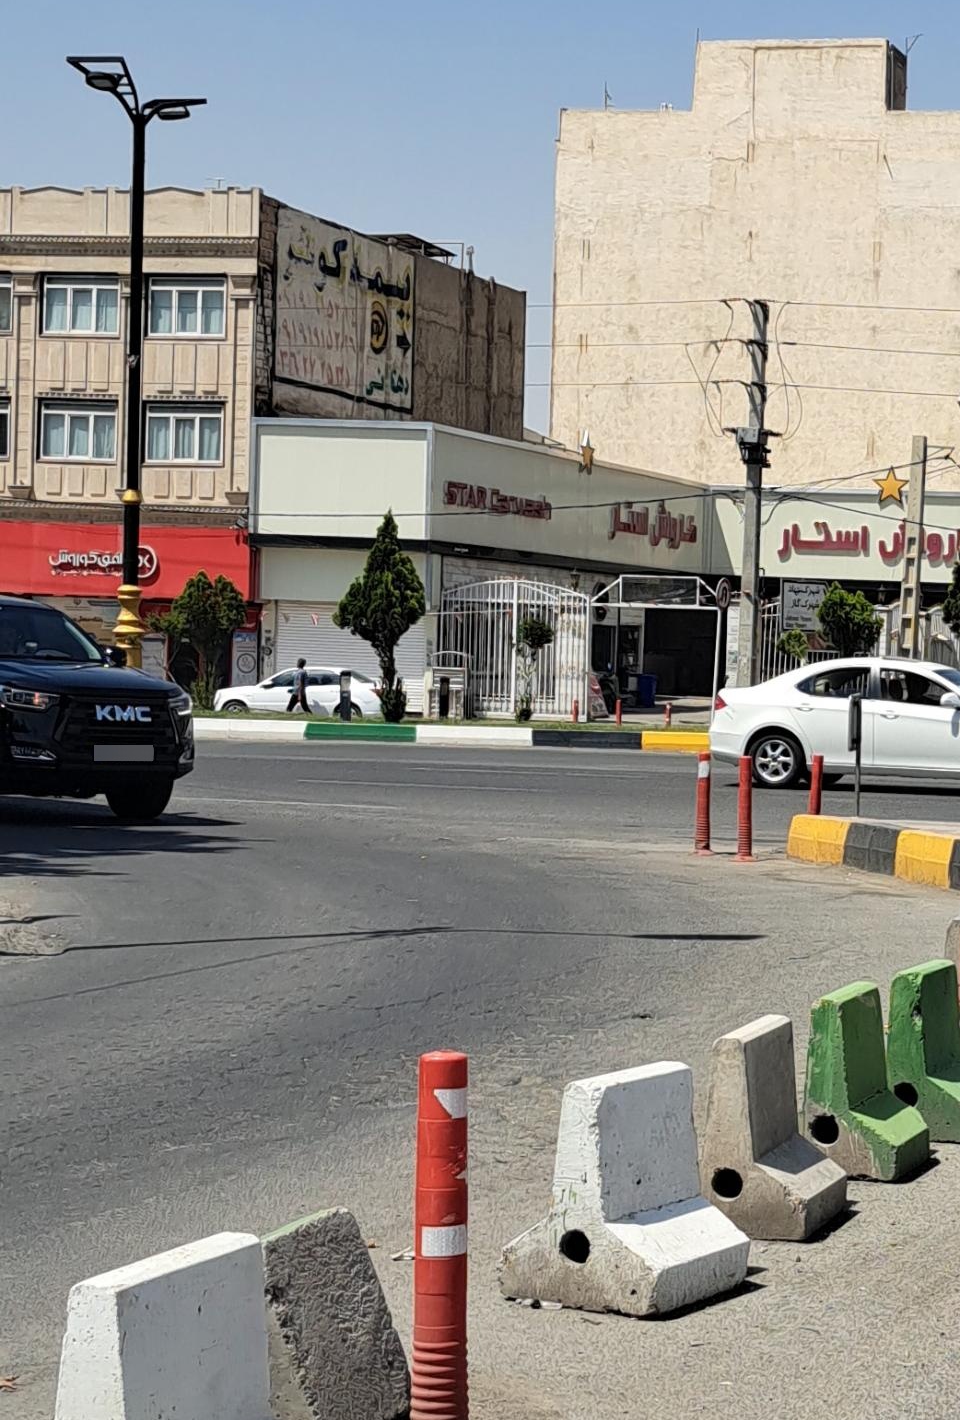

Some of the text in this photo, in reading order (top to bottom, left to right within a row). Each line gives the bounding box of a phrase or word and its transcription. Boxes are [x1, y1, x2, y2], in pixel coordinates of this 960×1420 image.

[444, 480, 487, 510] STAR
[608, 500, 697, 549] کارواش استار
[777, 521, 869, 562] استار
[49, 550, 123, 568] افق کوروش
[95, 704, 152, 722] KMC
